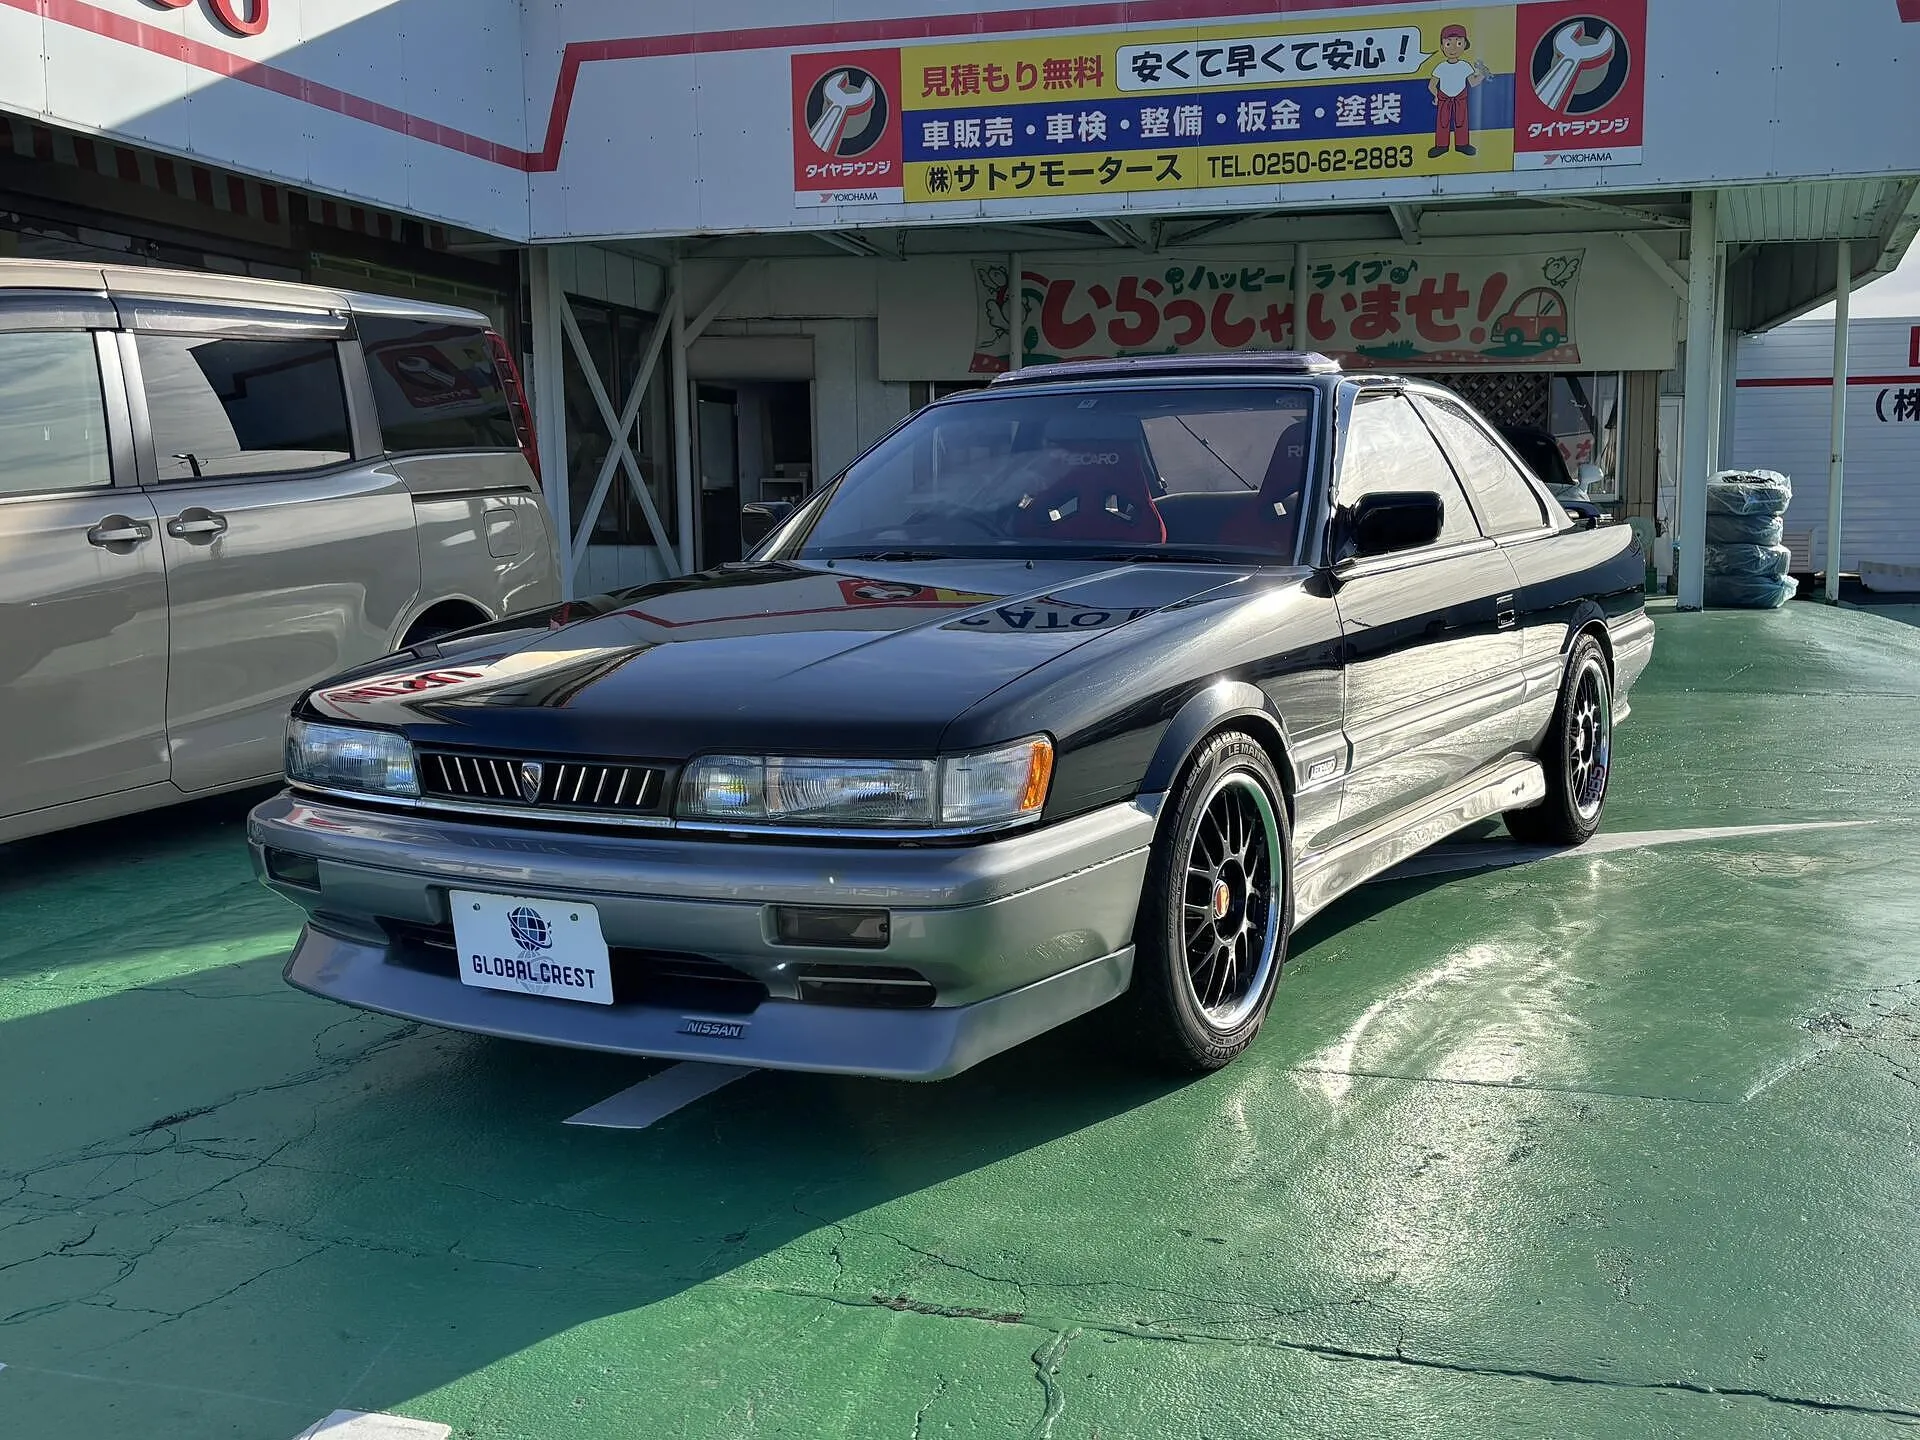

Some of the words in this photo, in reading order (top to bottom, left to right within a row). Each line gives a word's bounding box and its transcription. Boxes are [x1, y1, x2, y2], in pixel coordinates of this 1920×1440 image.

[1131, 36, 1409, 83] 安くて早くて安心!
[921, 54, 1104, 98] 見積もり無料
[1527, 117, 1629, 138] タイヤラウンジ
[1208, 145, 1413, 178] TEL.0250-62-2883
[1559, 151, 1612, 163] YOKOHAMA
[805, 161, 890, 178] タイヤラウンジ
[833, 192, 878, 201] YOKOHAMA
[1042, 272, 1509, 349] いらっしゃいませ!
[686, 1021, 741, 1037] NISSAN
